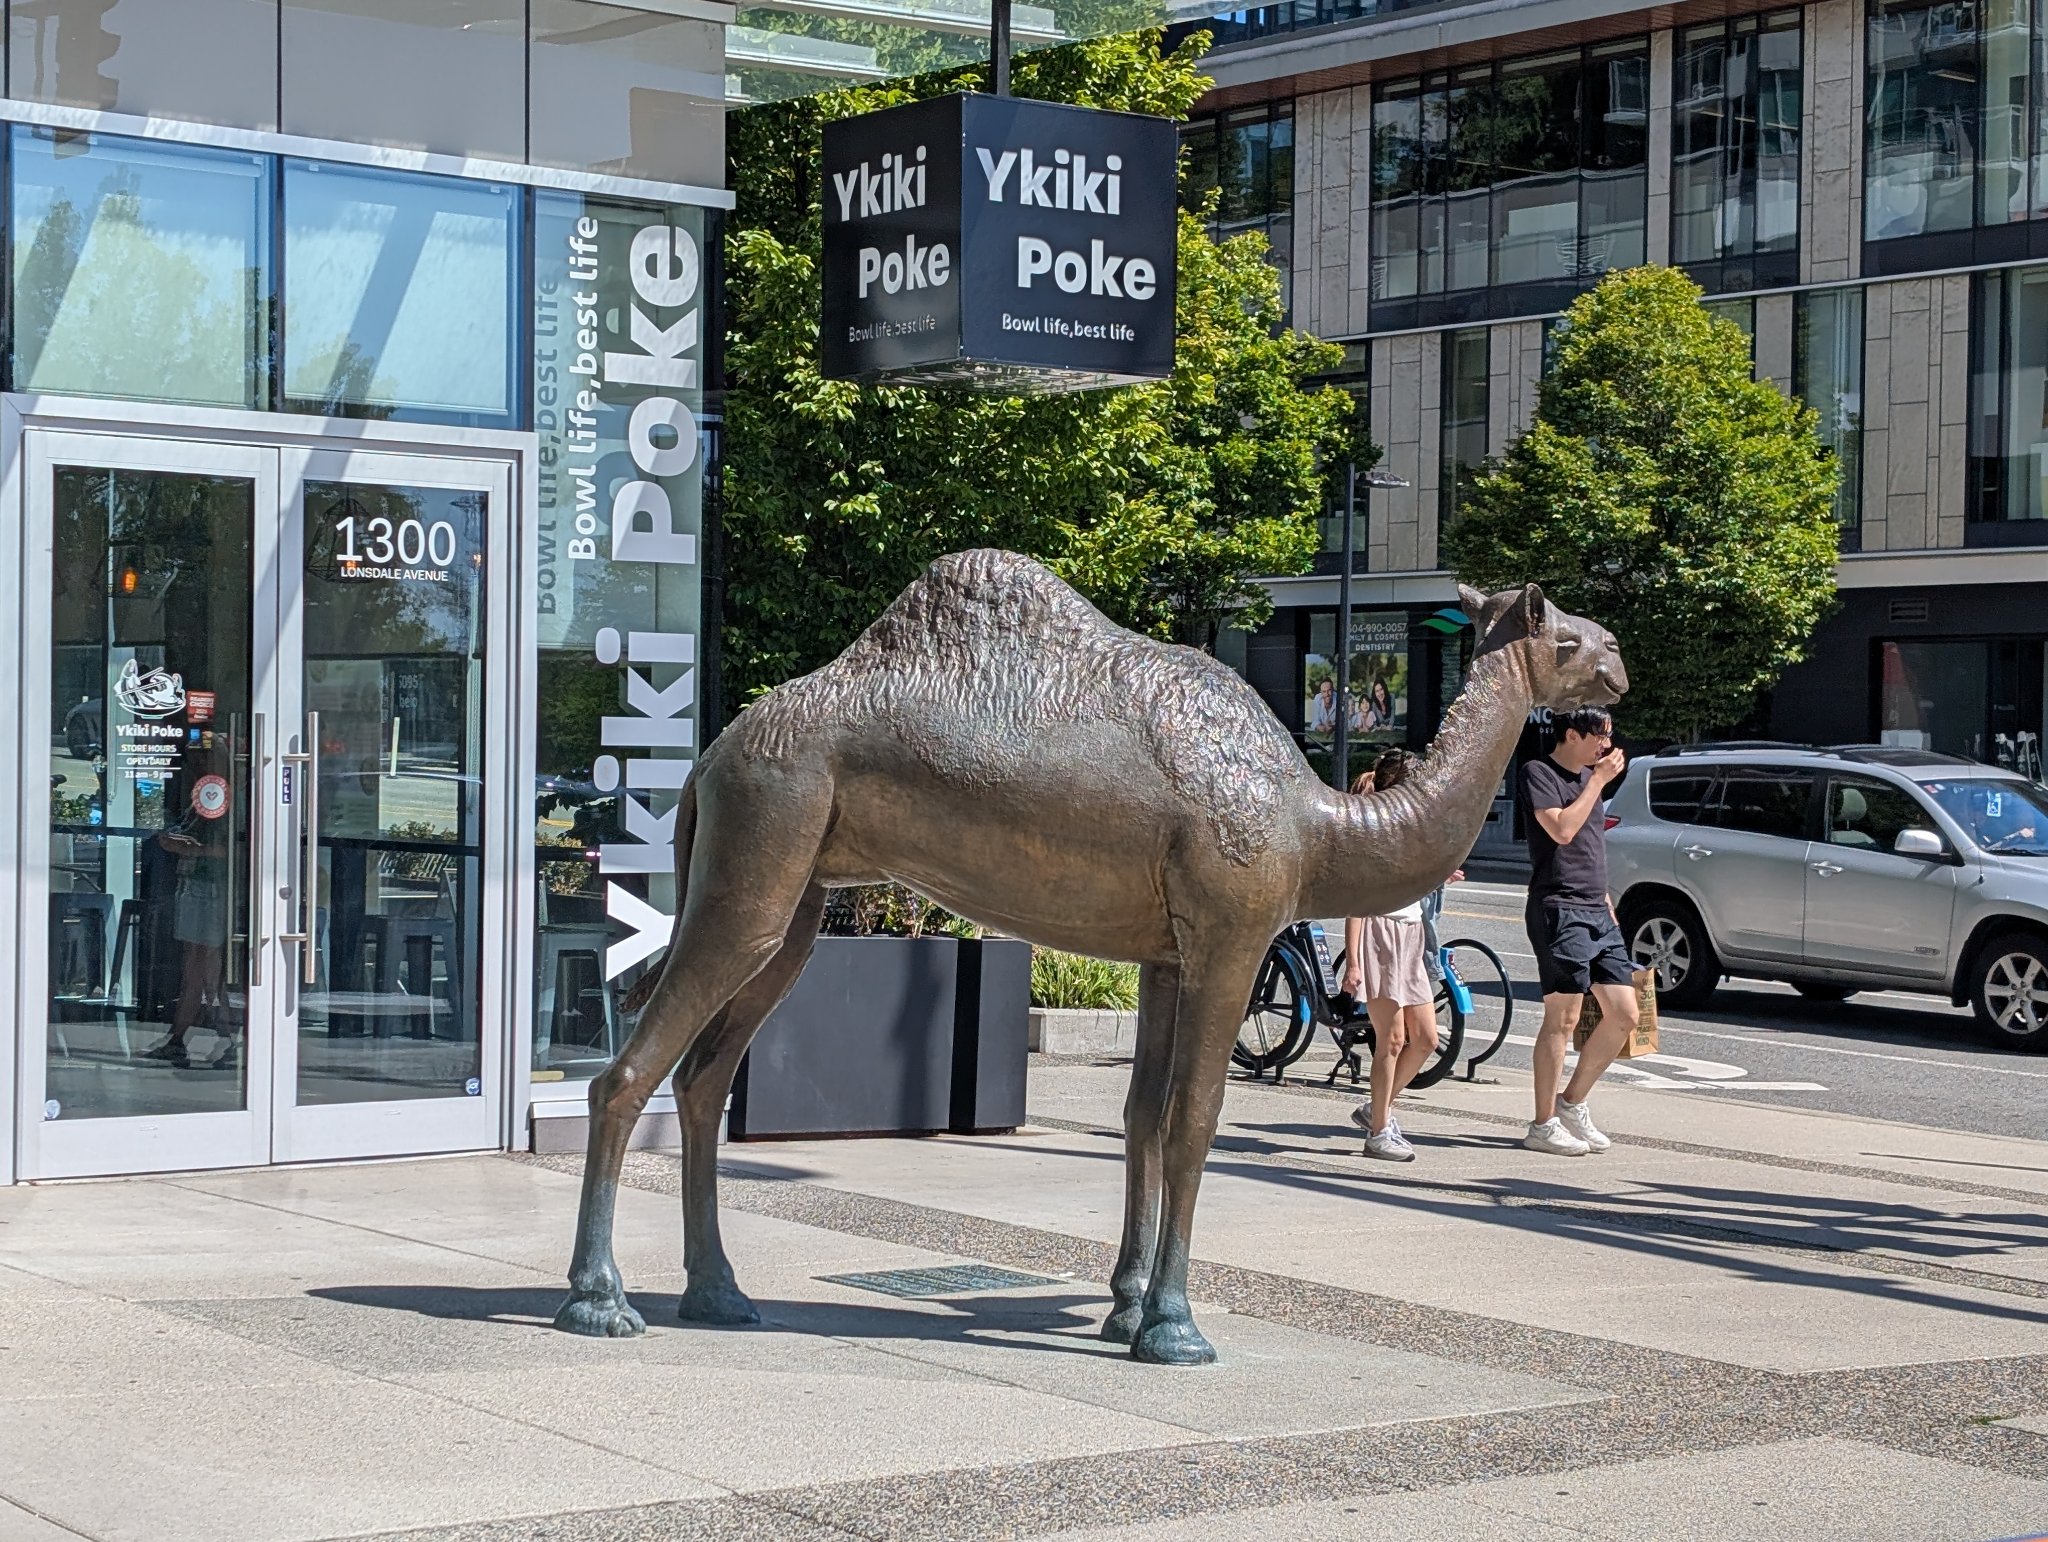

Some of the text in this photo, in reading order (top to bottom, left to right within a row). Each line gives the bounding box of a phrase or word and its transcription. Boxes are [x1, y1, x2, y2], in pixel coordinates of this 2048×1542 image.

[833, 145, 926, 222] Ykiki
[976, 147, 1122, 216] Ykiki
[569, 216, 599, 280] life
[859, 234, 950, 299] Poke
[1018, 236, 1157, 300] Poke
[849, 323, 873, 343] Bowl
[919, 313, 936, 332] life
[1002, 313, 1041, 333] Bowl
[1110, 323, 1135, 341] life
[568, 465, 597, 560] Bowl
[335, 516, 456, 567] 1300
[341, 566, 449, 582] LONSDALE AVENUE
[593, 225, 700, 982] Ykiki Poke
[1355, 643, 1396, 651] DENTISTRY
[116, 723, 150, 738] Ykiki
[151, 724, 184, 738] Poke
[121, 743, 177, 753] STORE HOURS
[126, 756, 172, 766] OPEN DAILY
